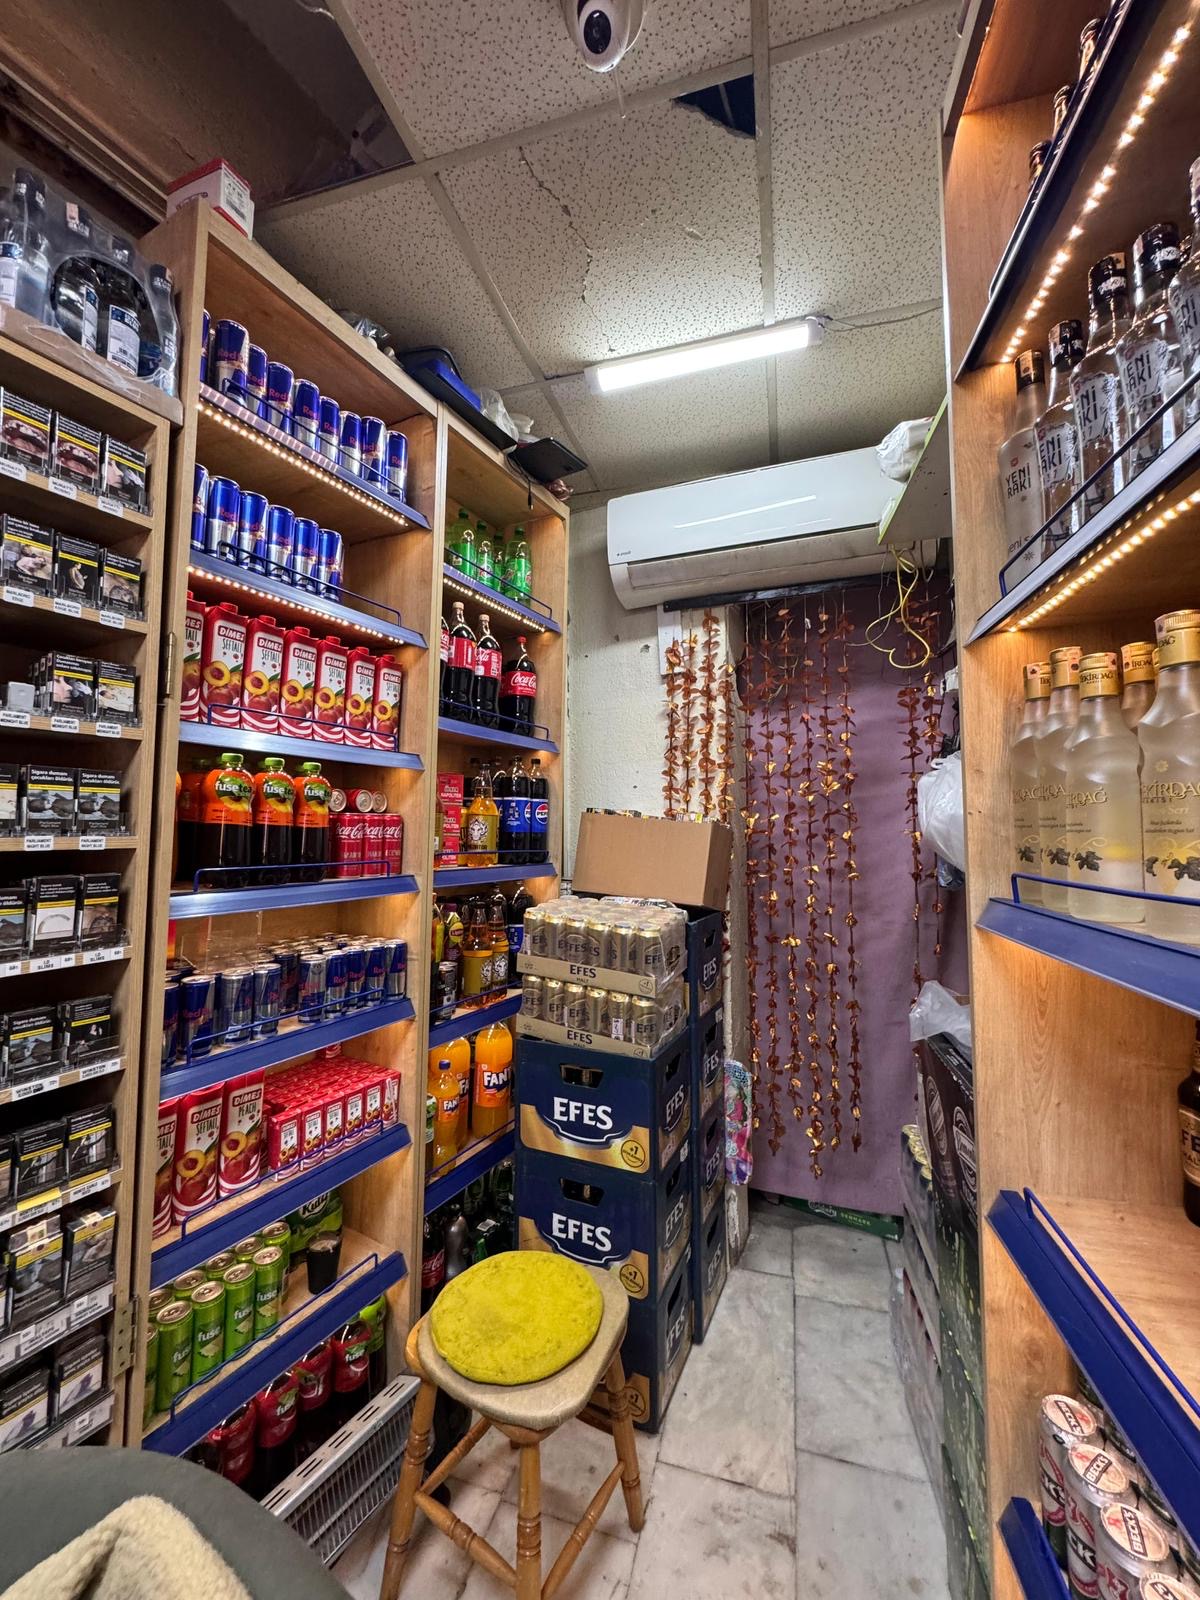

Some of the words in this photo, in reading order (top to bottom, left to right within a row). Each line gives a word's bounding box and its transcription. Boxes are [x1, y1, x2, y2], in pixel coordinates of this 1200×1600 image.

[569, 964, 597, 979] EFES
[567, 1030, 593, 1045] EFES
[238, 1103, 257, 1118] PEACH
[666, 1084, 685, 1122] EFES
[553, 1096, 614, 1131] EFES
[665, 1194, 684, 1241] EFES
[551, 1212, 612, 1253] EFES
[256, 1290, 278, 1303] fuse
[197, 1326, 222, 1344] fuse
